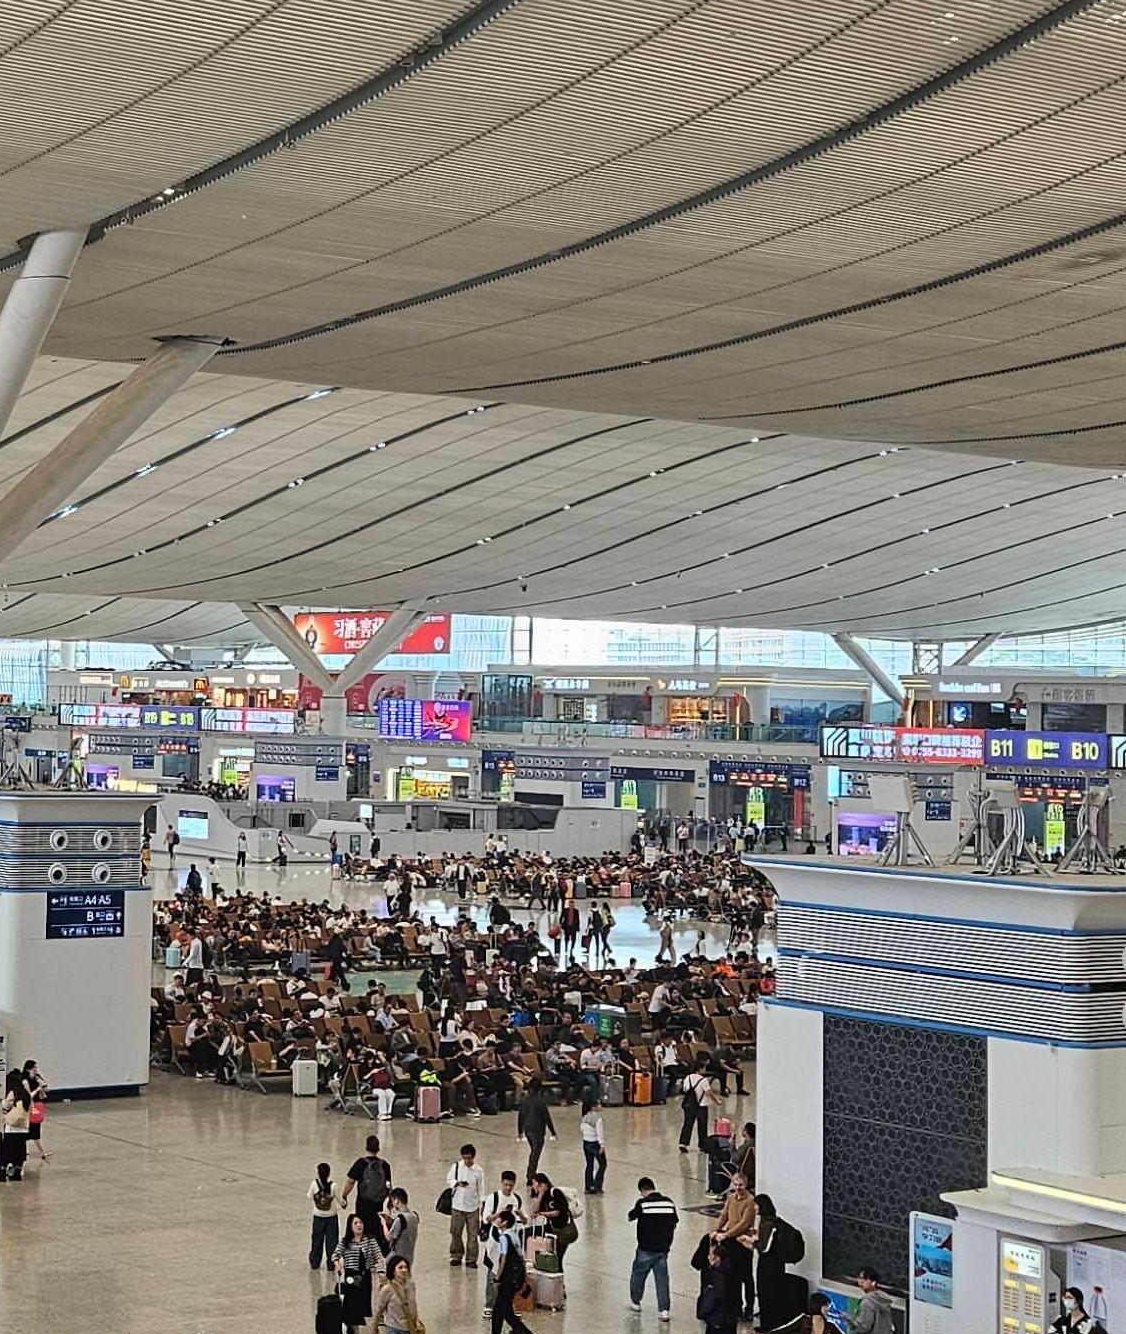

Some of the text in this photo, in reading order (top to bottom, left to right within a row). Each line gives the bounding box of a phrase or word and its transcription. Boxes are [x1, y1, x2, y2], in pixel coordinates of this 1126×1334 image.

[991, 739, 1013, 757] B11
[1071, 742, 1099, 760] B10
[713, 773, 725, 782] B13
